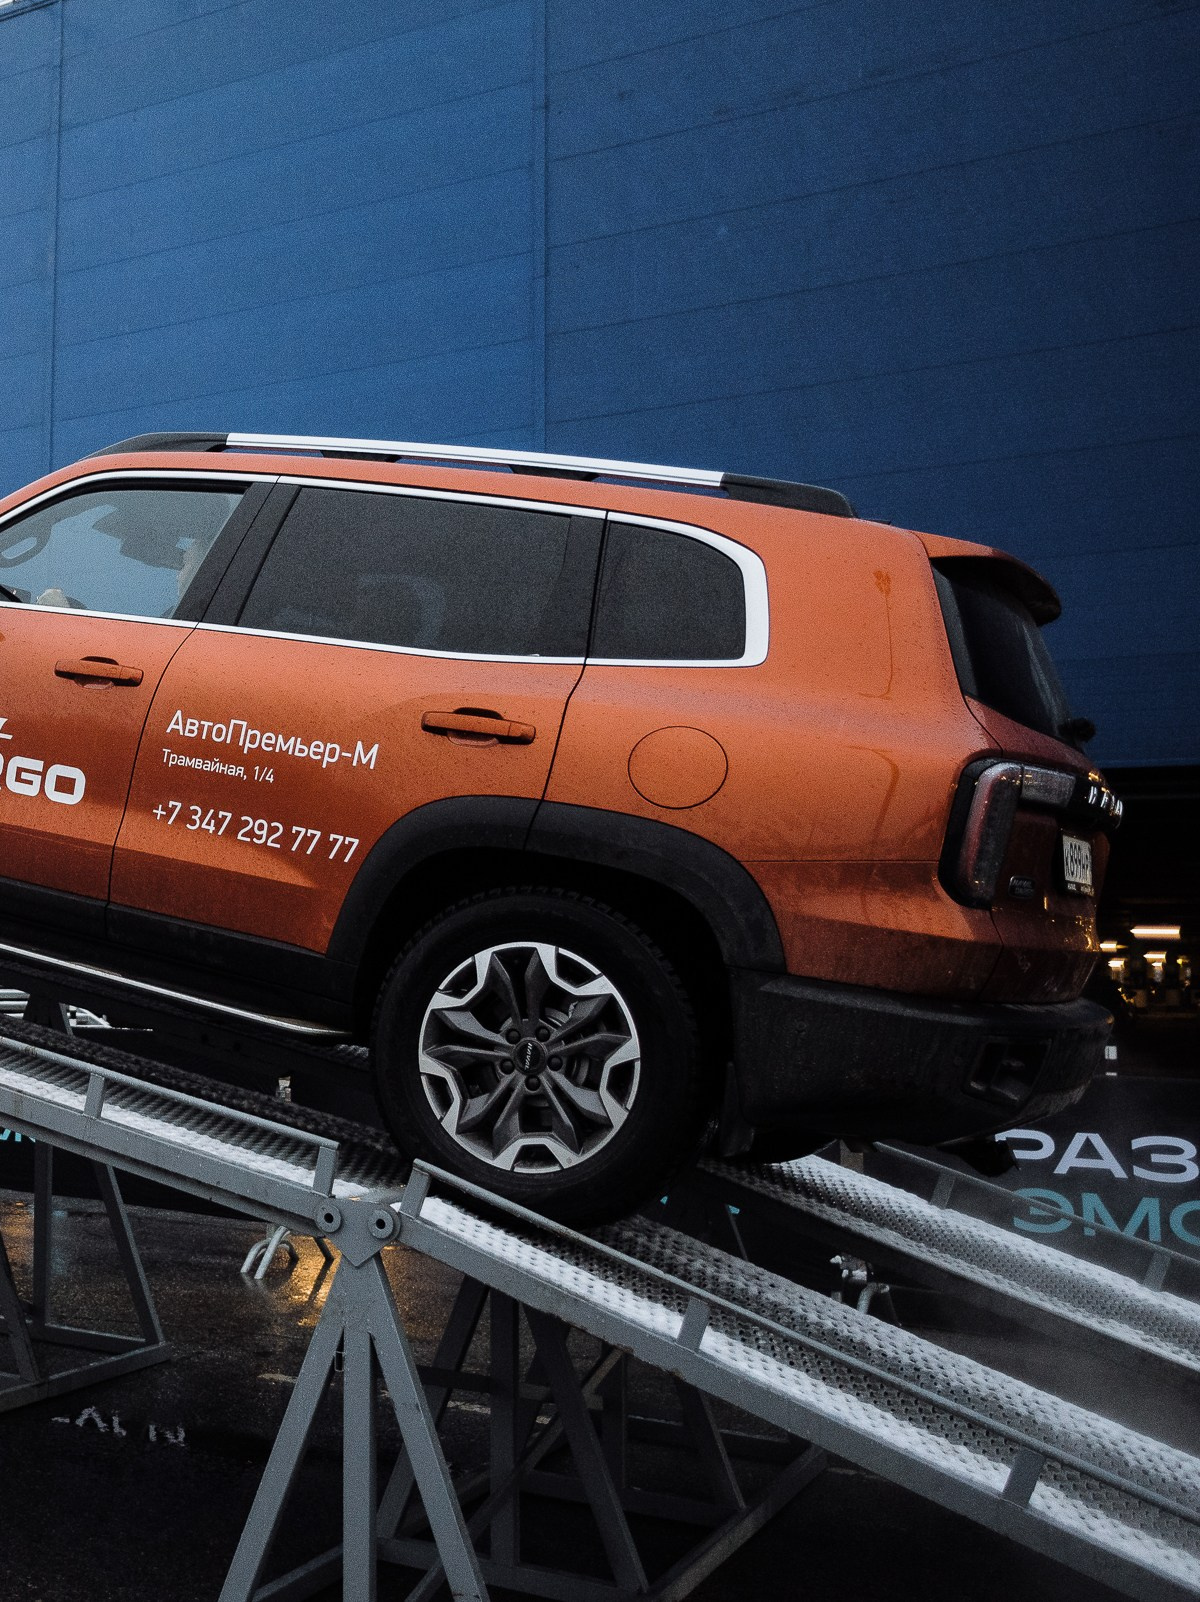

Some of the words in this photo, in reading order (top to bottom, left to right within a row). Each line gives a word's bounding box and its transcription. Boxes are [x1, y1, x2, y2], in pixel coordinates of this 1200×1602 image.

[162, 748, 248, 783] Трамвайная,
[254, 765, 275, 783] 1/4
[165, 709, 380, 770] АвтоПремьер-М
[152, 801, 182, 825] +7
[185, 805, 233, 836] 347
[237, 815, 284, 849] 292
[291, 825, 322, 855] 77
[328, 833, 360, 863] 77
